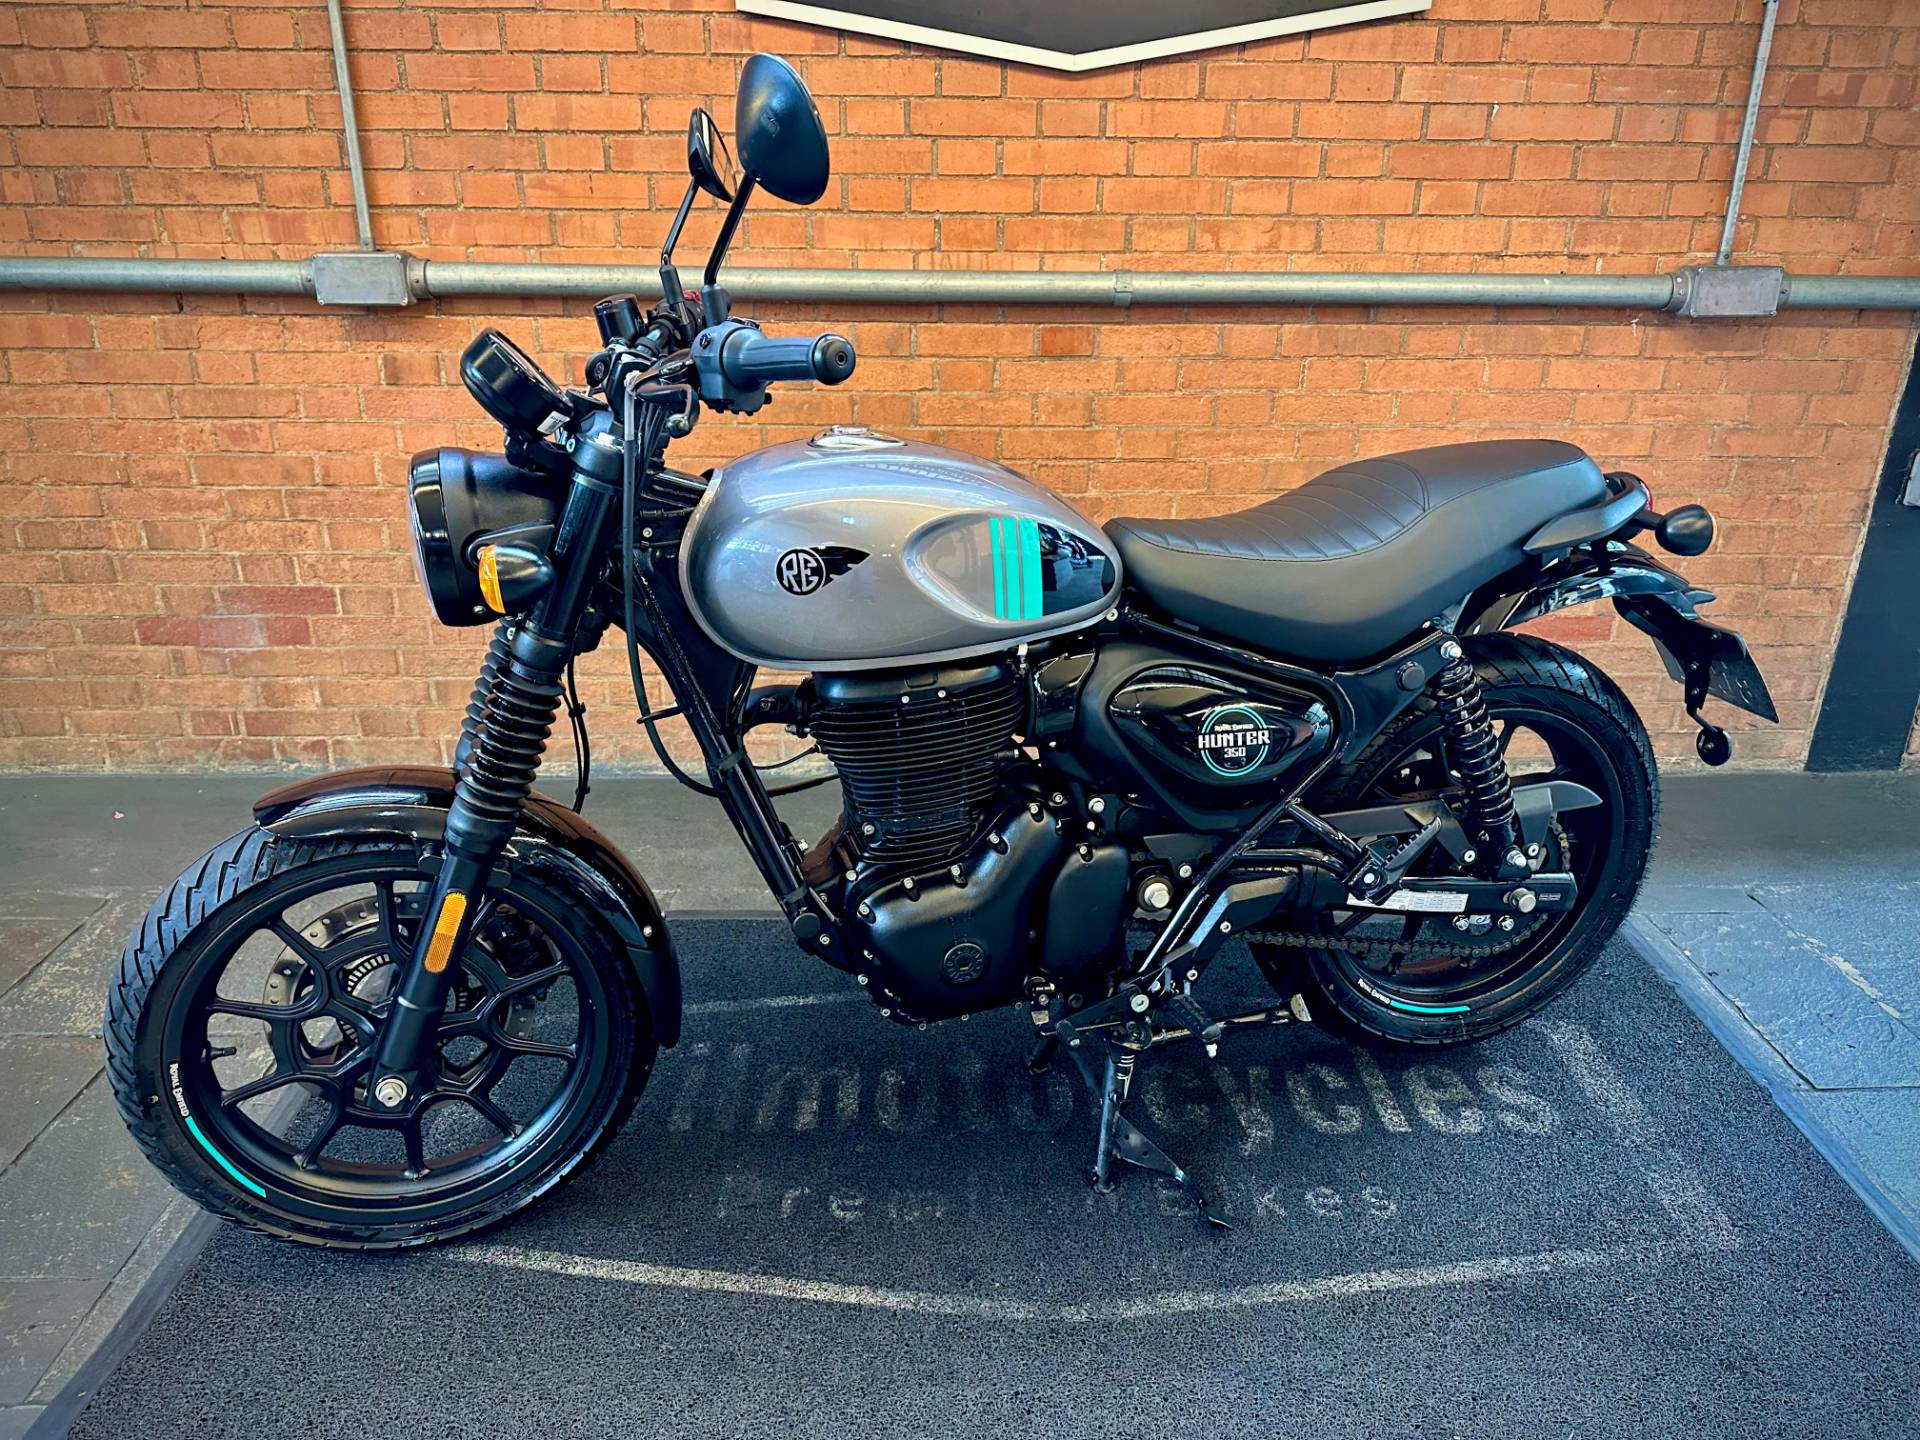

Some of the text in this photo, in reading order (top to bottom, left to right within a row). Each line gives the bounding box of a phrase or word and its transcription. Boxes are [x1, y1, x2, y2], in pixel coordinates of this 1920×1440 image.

[780, 552, 819, 593] RE
[1198, 730, 1270, 749] HUNTER
[1224, 747, 1246, 758] 350
